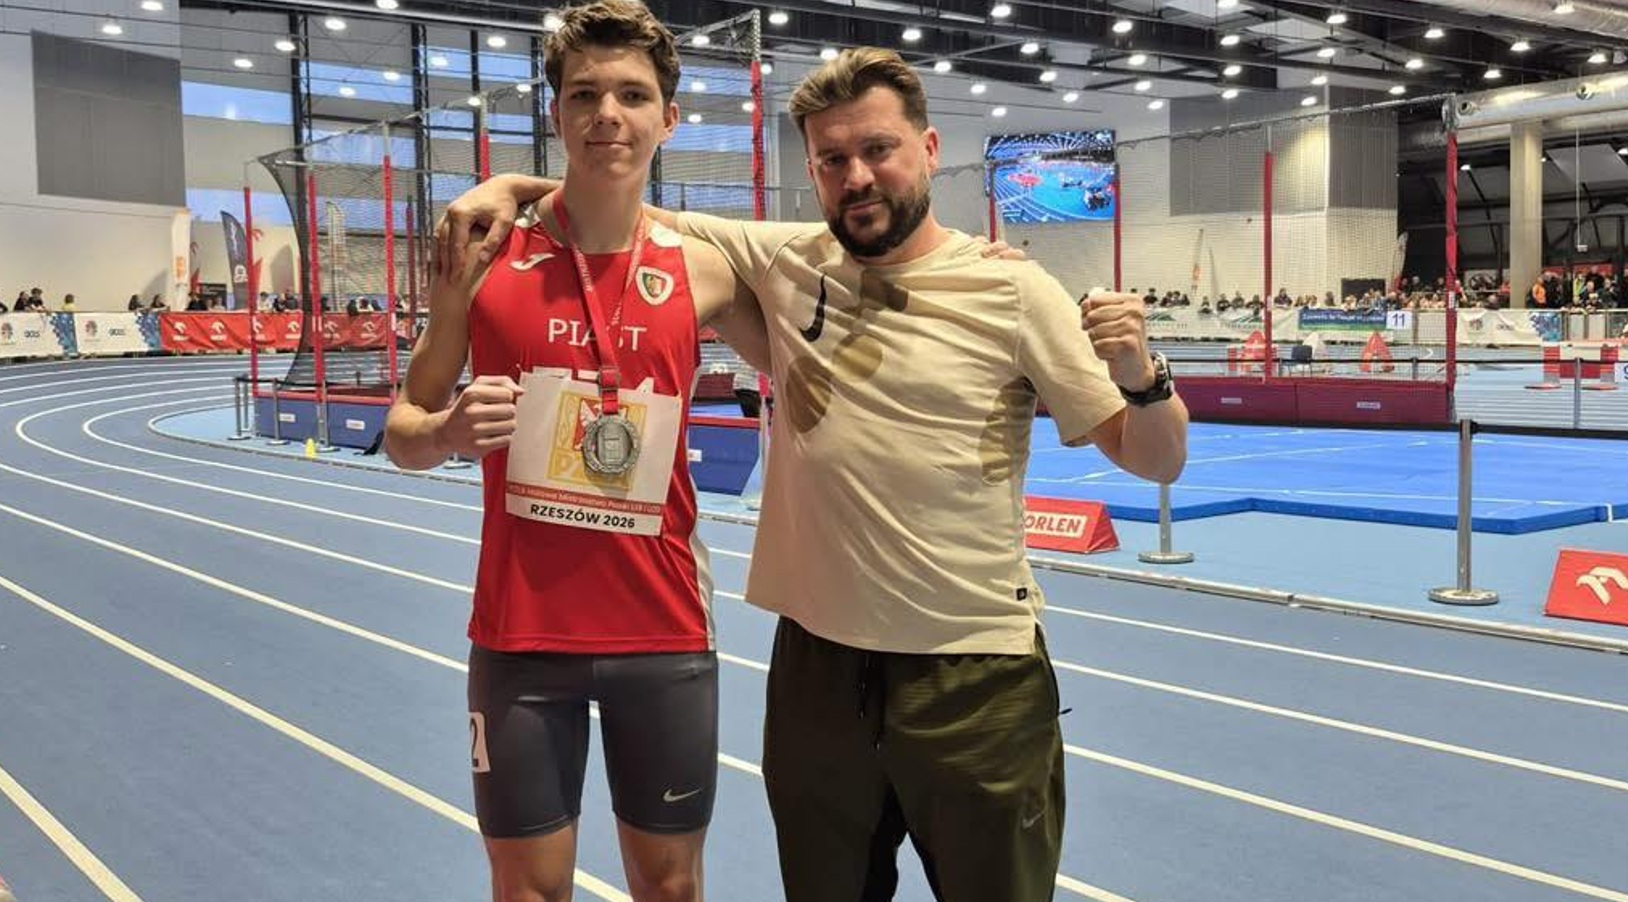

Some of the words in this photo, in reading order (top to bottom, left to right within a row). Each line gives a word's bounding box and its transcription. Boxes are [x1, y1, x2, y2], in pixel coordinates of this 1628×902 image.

[1392, 313, 1405, 327] 11
[530, 504, 601, 524] RZESZÓW
[603, 514, 635, 529] 2026
[1025, 515, 1081, 532] ORLEN
